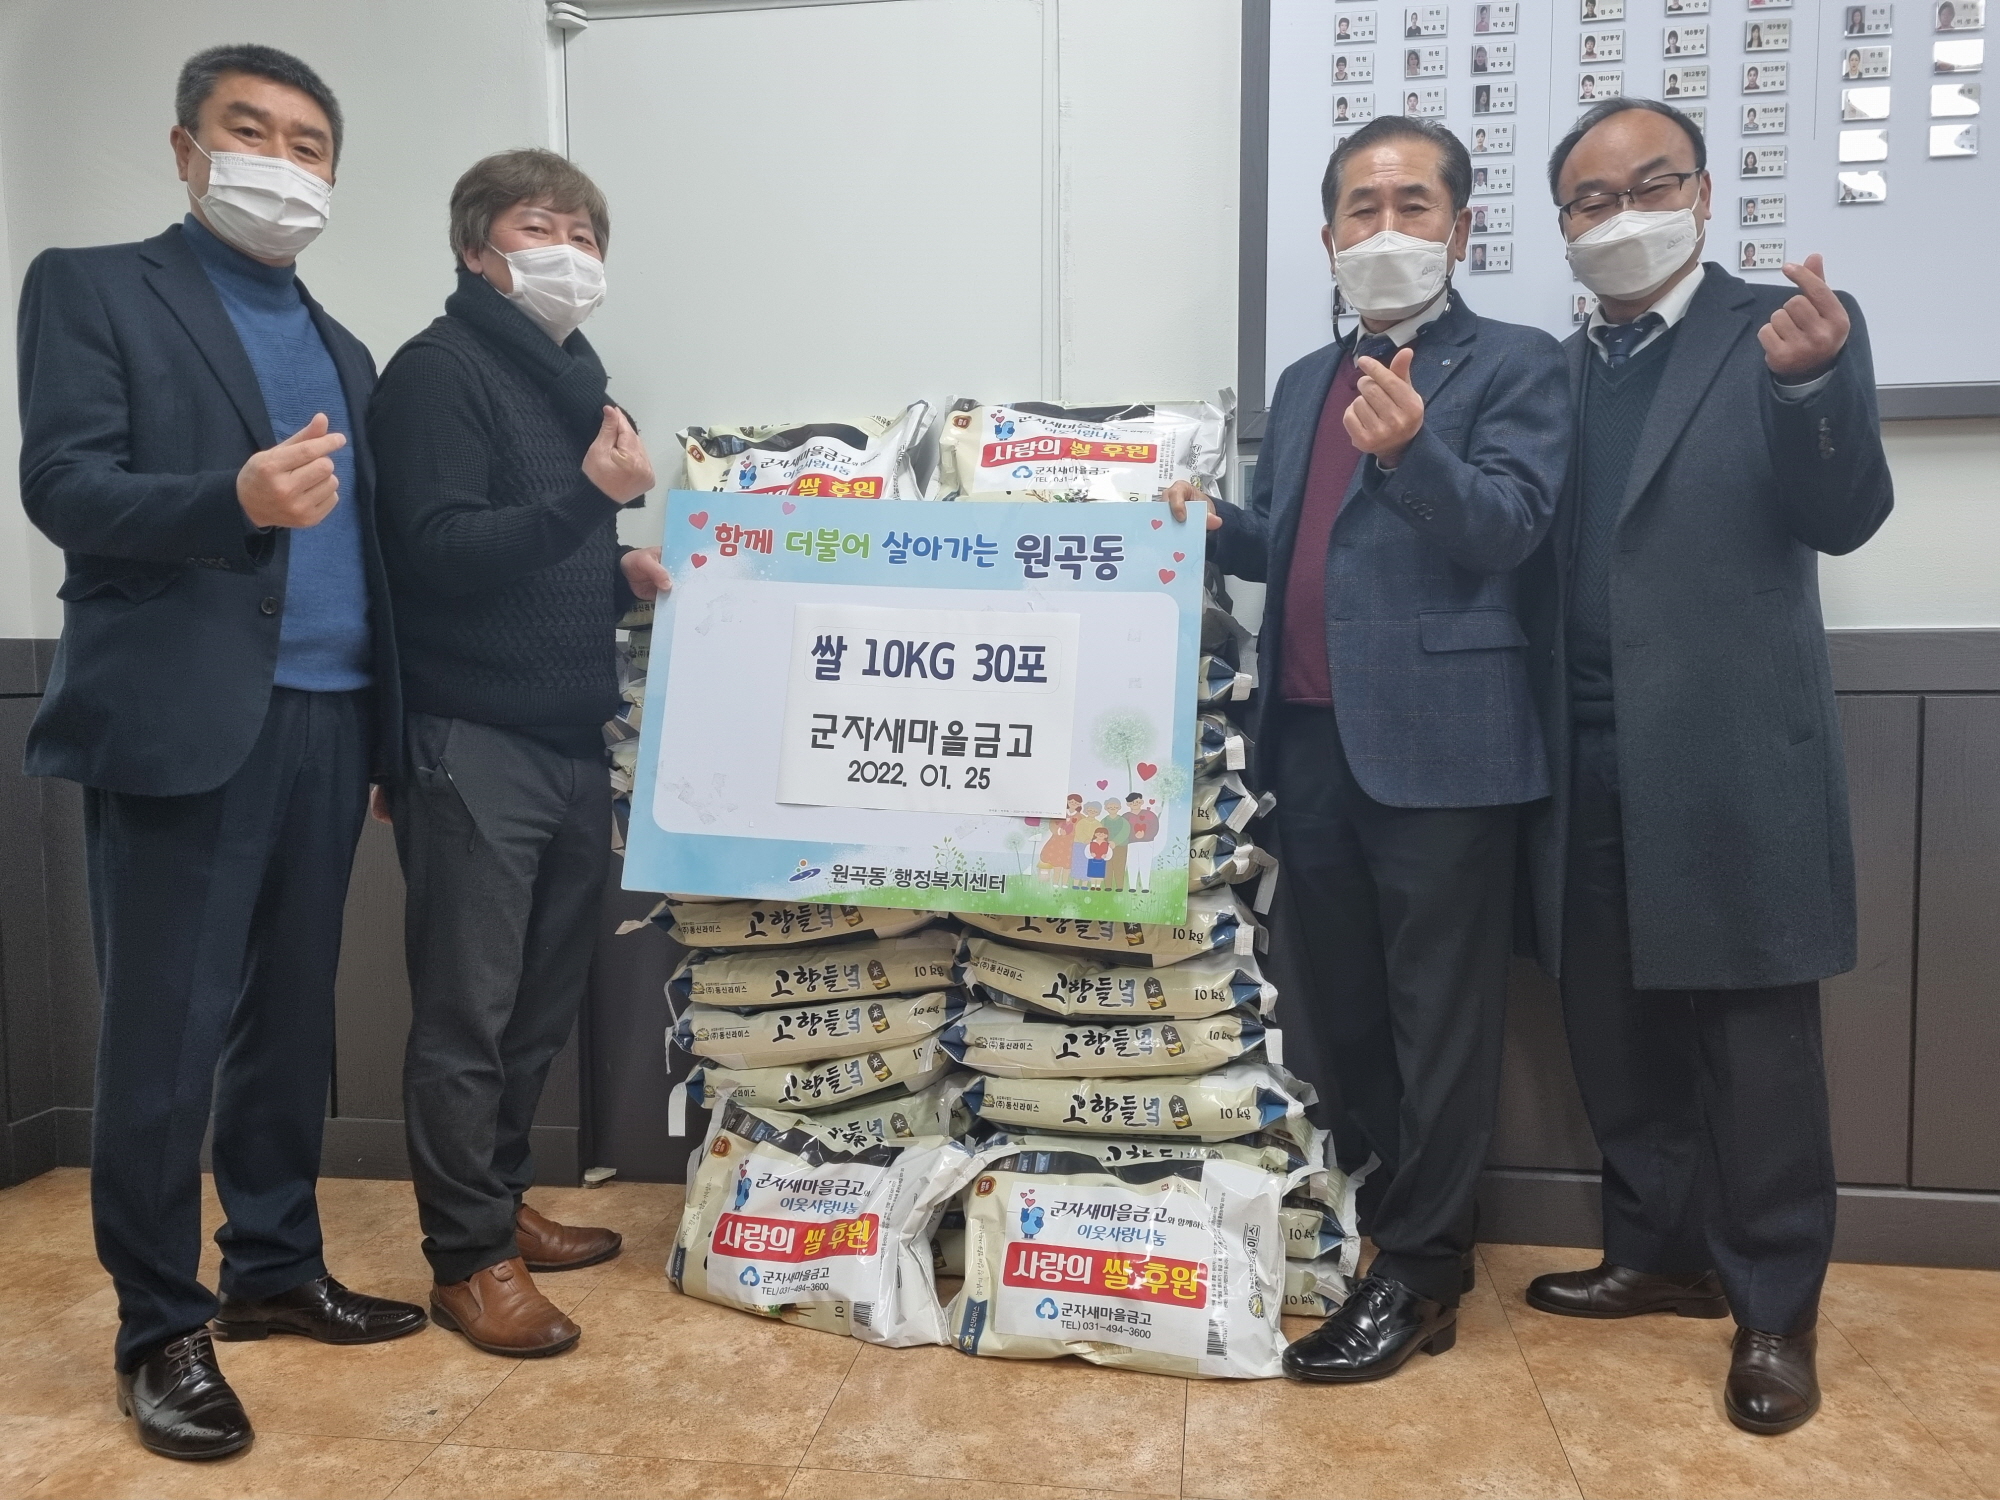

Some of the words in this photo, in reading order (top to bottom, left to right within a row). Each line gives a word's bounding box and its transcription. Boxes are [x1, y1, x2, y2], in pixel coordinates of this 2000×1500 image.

[993, 439, 1061, 463] 사랑의
[1070, 440, 1093, 456] 쌀
[1101, 444, 1149, 459] 후원
[797, 478, 822, 497] 쌀
[829, 481, 875, 498] 후원
[714, 523, 774, 557] 함께
[785, 528, 870, 563] 더불어
[882, 531, 999, 568] 살아가는
[1014, 534, 1126, 581] 원곡동
[811, 634, 848, 681] 쌀
[862, 638, 955, 680] 10KG
[972, 643, 1048, 683] 30포
[811, 713, 1033, 759] 군자새마을금고
[847, 759, 907, 787] 2022.
[920, 764, 951, 790] 01.
[964, 766, 991, 790] 25
[831, 864, 887, 886] 원곡동
[894, 868, 1006, 893] 행정복지센터
[780, 1197, 860, 1215] 이웃사랑나눔
[720, 1221, 796, 1254] 사랑의
[804, 1228, 826, 1255] 쌀
[828, 1220, 870, 1249] 후원
[1077, 1224, 1167, 1247] 이웃사랑나눔
[763, 1267, 829, 1284] 군자새마을금고
[1012, 1250, 1093, 1285] 사랑의
[1103, 1258, 1130, 1290] 쌀
[1143, 1261, 1197, 1299] 후원
[1061, 1303, 1152, 1325] 군자새마을금고
